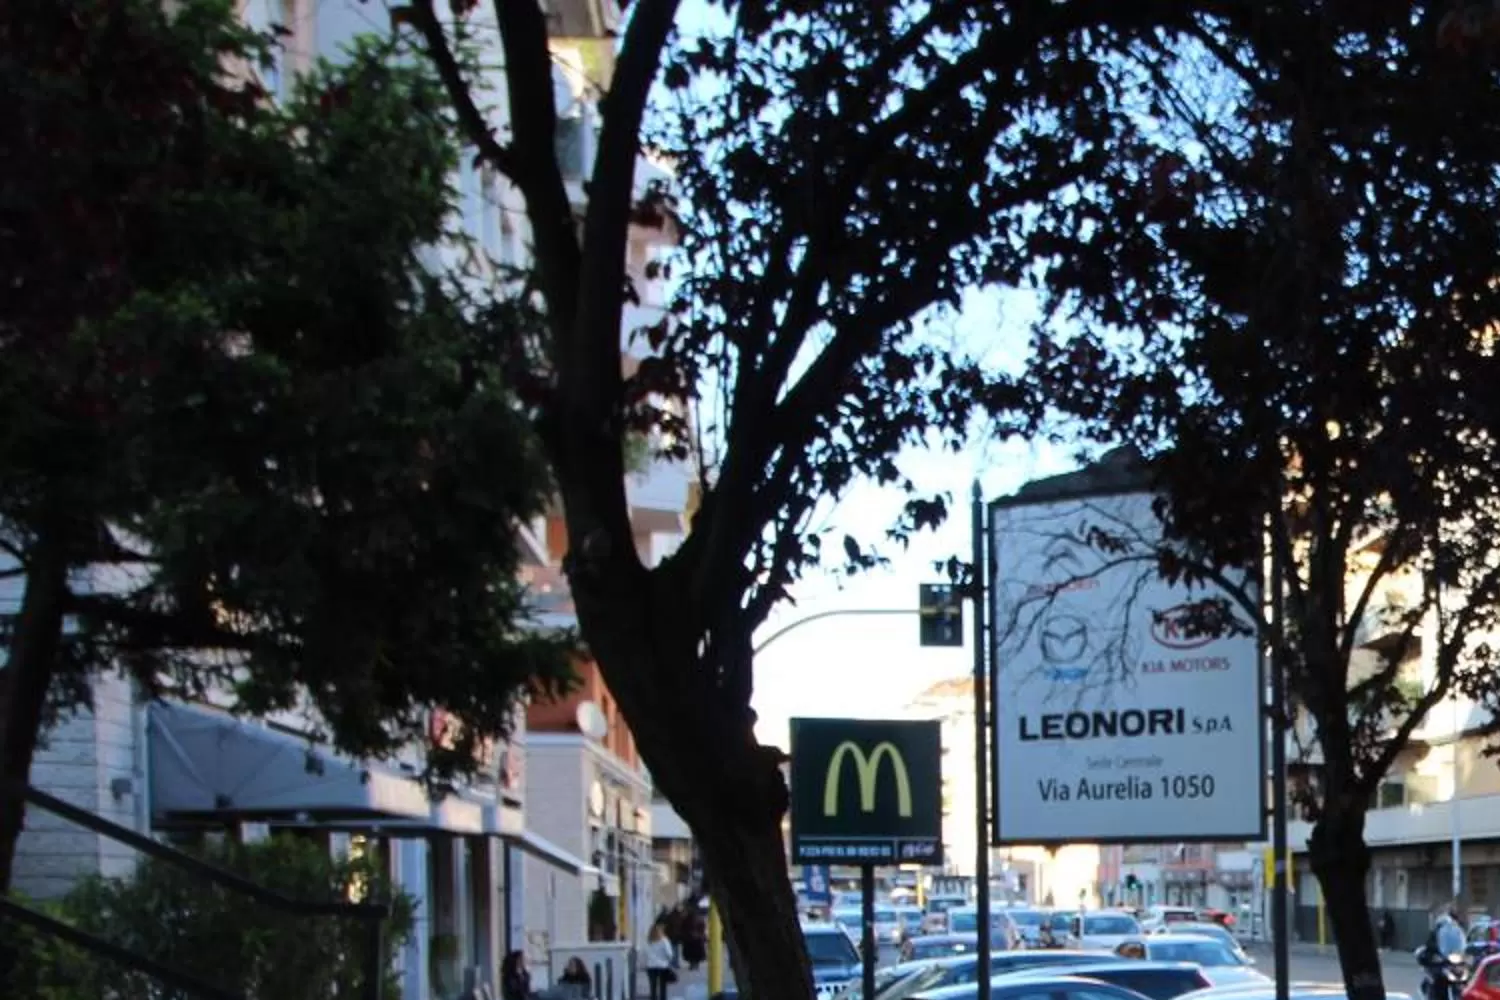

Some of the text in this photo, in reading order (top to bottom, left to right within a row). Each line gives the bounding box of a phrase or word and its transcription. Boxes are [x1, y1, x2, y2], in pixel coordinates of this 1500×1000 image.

[1171, 656, 1230, 673] MOTORS
[1018, 707, 1186, 742] LEONORI
[1086, 753, 1164, 771] Sede Centrale
[1038, 773, 1216, 802] Via Aurelia 1050
